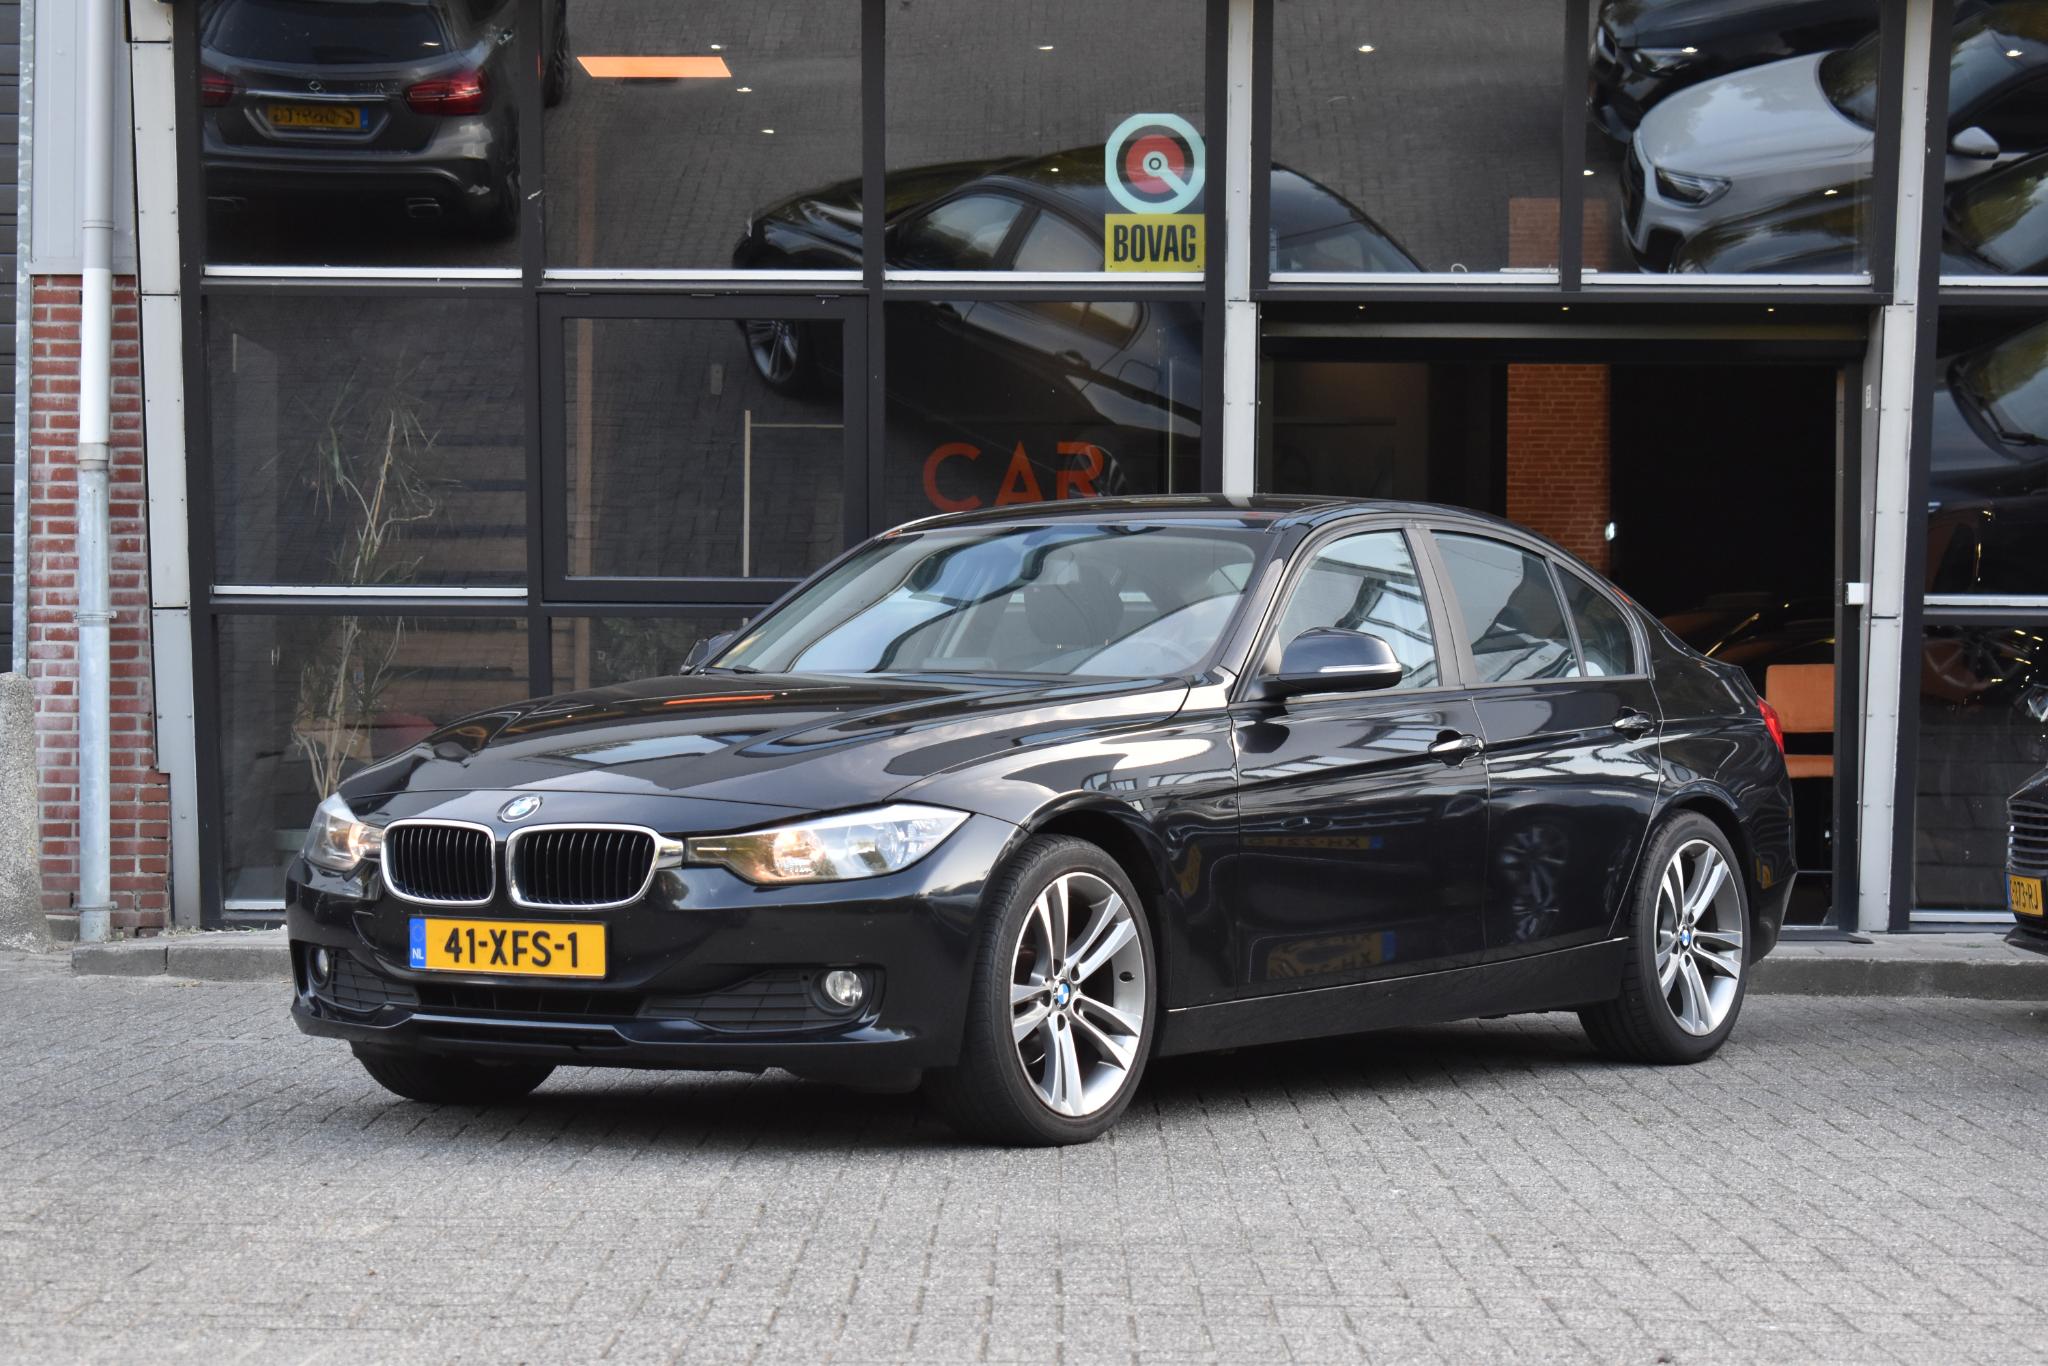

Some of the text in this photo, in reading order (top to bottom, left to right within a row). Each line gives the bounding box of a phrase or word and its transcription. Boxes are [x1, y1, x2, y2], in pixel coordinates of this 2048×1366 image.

[1113, 224, 1197, 263] BOVAG
[923, 440, 1104, 512] CAR
[412, 948, 424, 960] NL
[444, 927, 578, 968] 41-XFS-1
